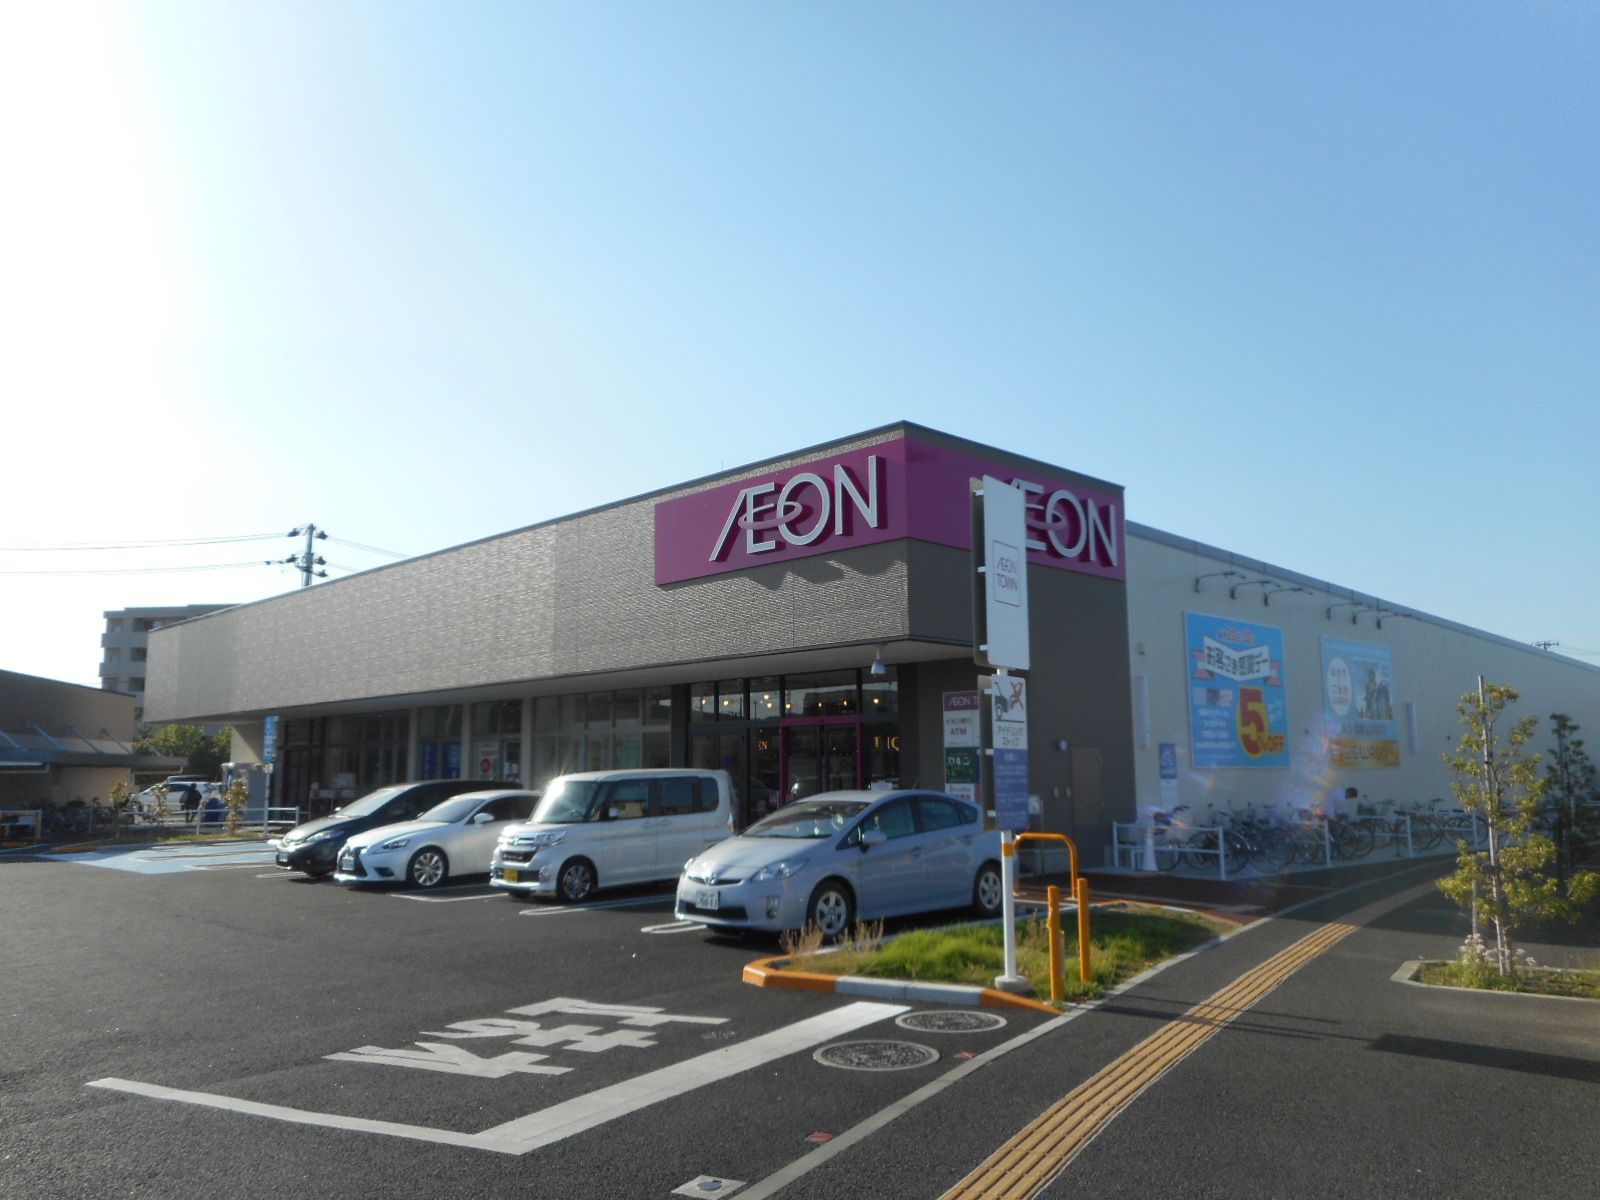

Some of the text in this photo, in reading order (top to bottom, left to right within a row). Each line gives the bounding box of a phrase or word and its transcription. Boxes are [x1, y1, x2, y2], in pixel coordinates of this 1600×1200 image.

[1010, 478, 1119, 567] EON
[996, 573, 1018, 591] TOWN
[1206, 645, 1269, 676] お客さま感謝デー
[950, 727, 967, 736] ATM
[321, 997, 731, 1079] 止まれ
